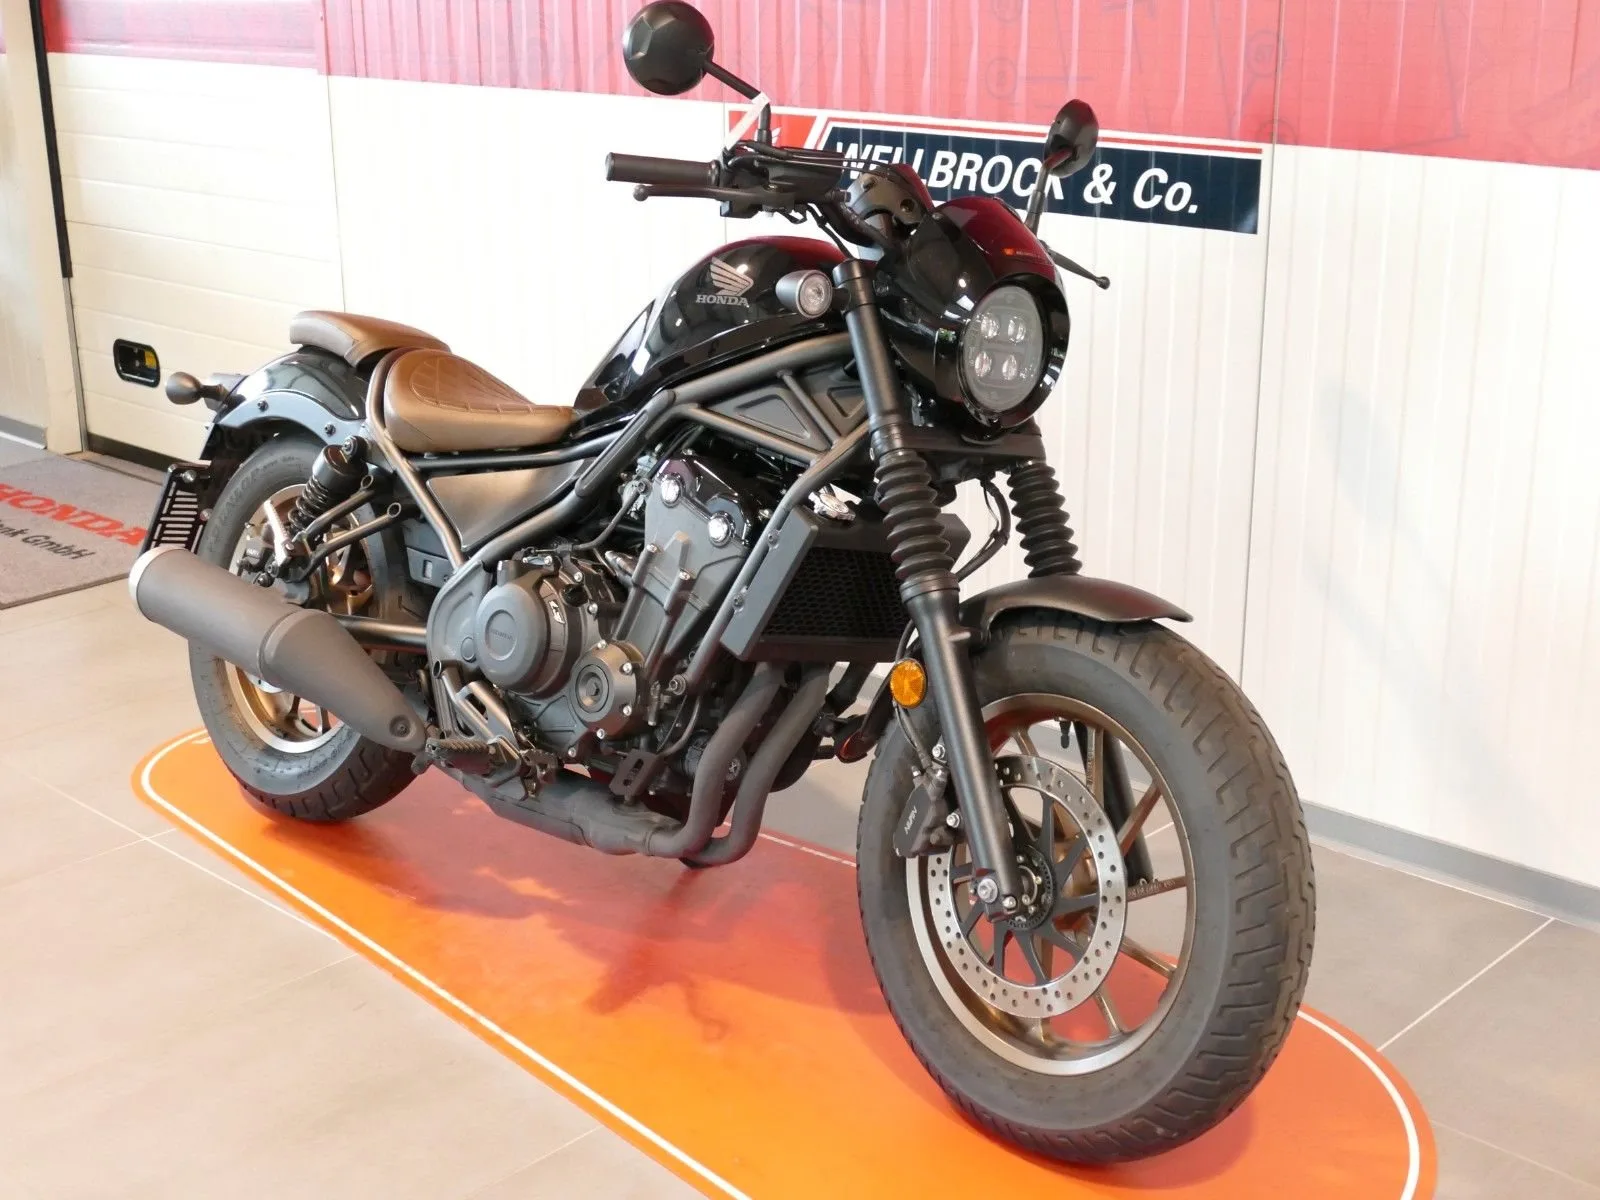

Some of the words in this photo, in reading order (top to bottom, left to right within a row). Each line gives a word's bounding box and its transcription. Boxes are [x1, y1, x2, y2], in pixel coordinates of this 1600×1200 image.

[1083, 163, 1117, 205] &
[1133, 167, 1198, 214] Co.
[695, 294, 750, 307] HONDA
[0, 483, 147, 546] HONDA
[22, 535, 96, 559] GmbH
